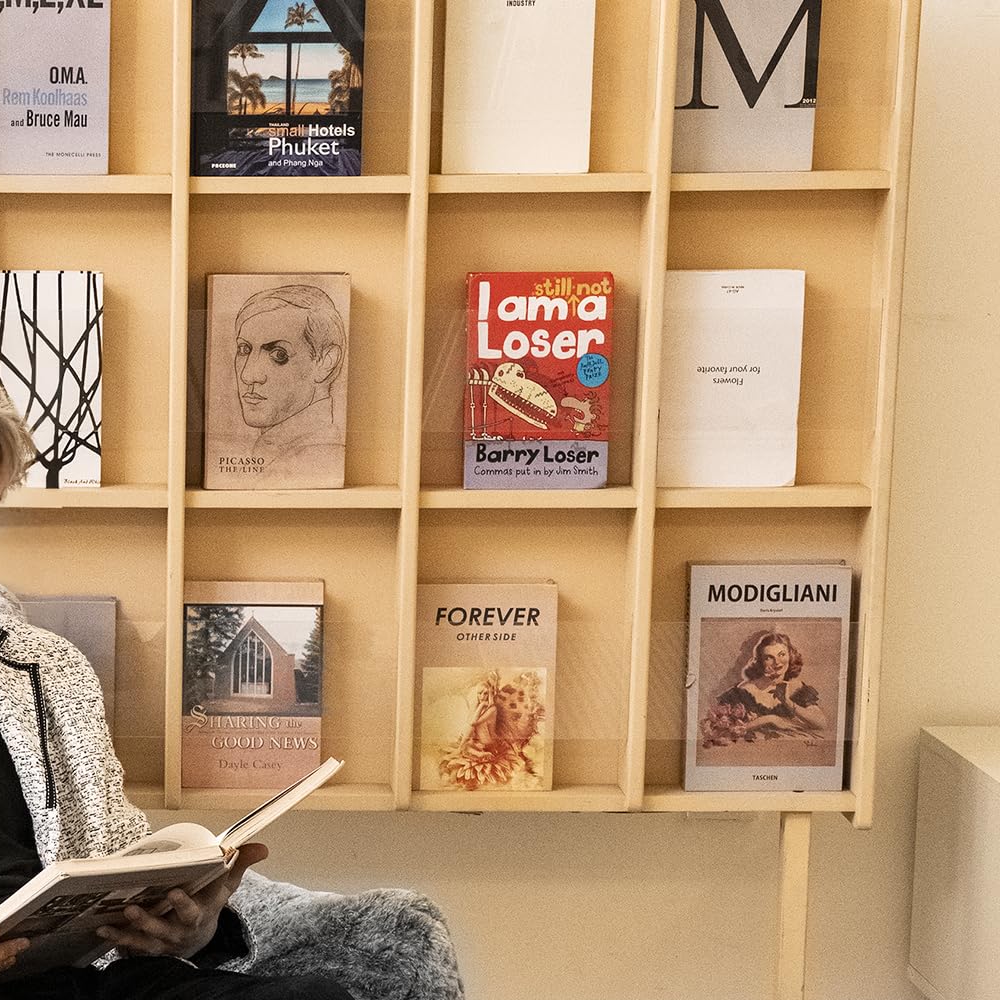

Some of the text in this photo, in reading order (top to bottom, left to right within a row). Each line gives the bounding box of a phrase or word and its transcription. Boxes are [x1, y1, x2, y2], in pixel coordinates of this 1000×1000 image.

[49, 66, 88, 84] O.M.A.
[2, 87, 88, 106] Rem Koolhaas
[10, 109, 88, 128] and Bruce Mau
[268, 123, 356, 137] small Hotels
[268, 137, 340, 156] Phuket
[283, 159, 307, 169] Phang
[308, 159, 324, 168] Nga
[535, 277, 612, 297] still not
[478, 281, 607, 322] I am a
[477, 321, 605, 360] Loser
[696, 364, 761, 375] for your favorite
[712, 377, 744, 386] Flowers
[219, 457, 265, 466] PICASSO
[476, 443, 600, 466] Barry Loser
[474, 465, 599, 478] Commas put in by Jim Smith
[707, 584, 838, 602] MODIGLIANI
[435, 607, 541, 626] FOREVER
[456, 632, 517, 641] OTHER SIDE
[185, 704, 303, 733] SHARING the
[211, 736, 320, 750] GOOD NEWS
[219, 760, 284, 770] Dayle Casey
